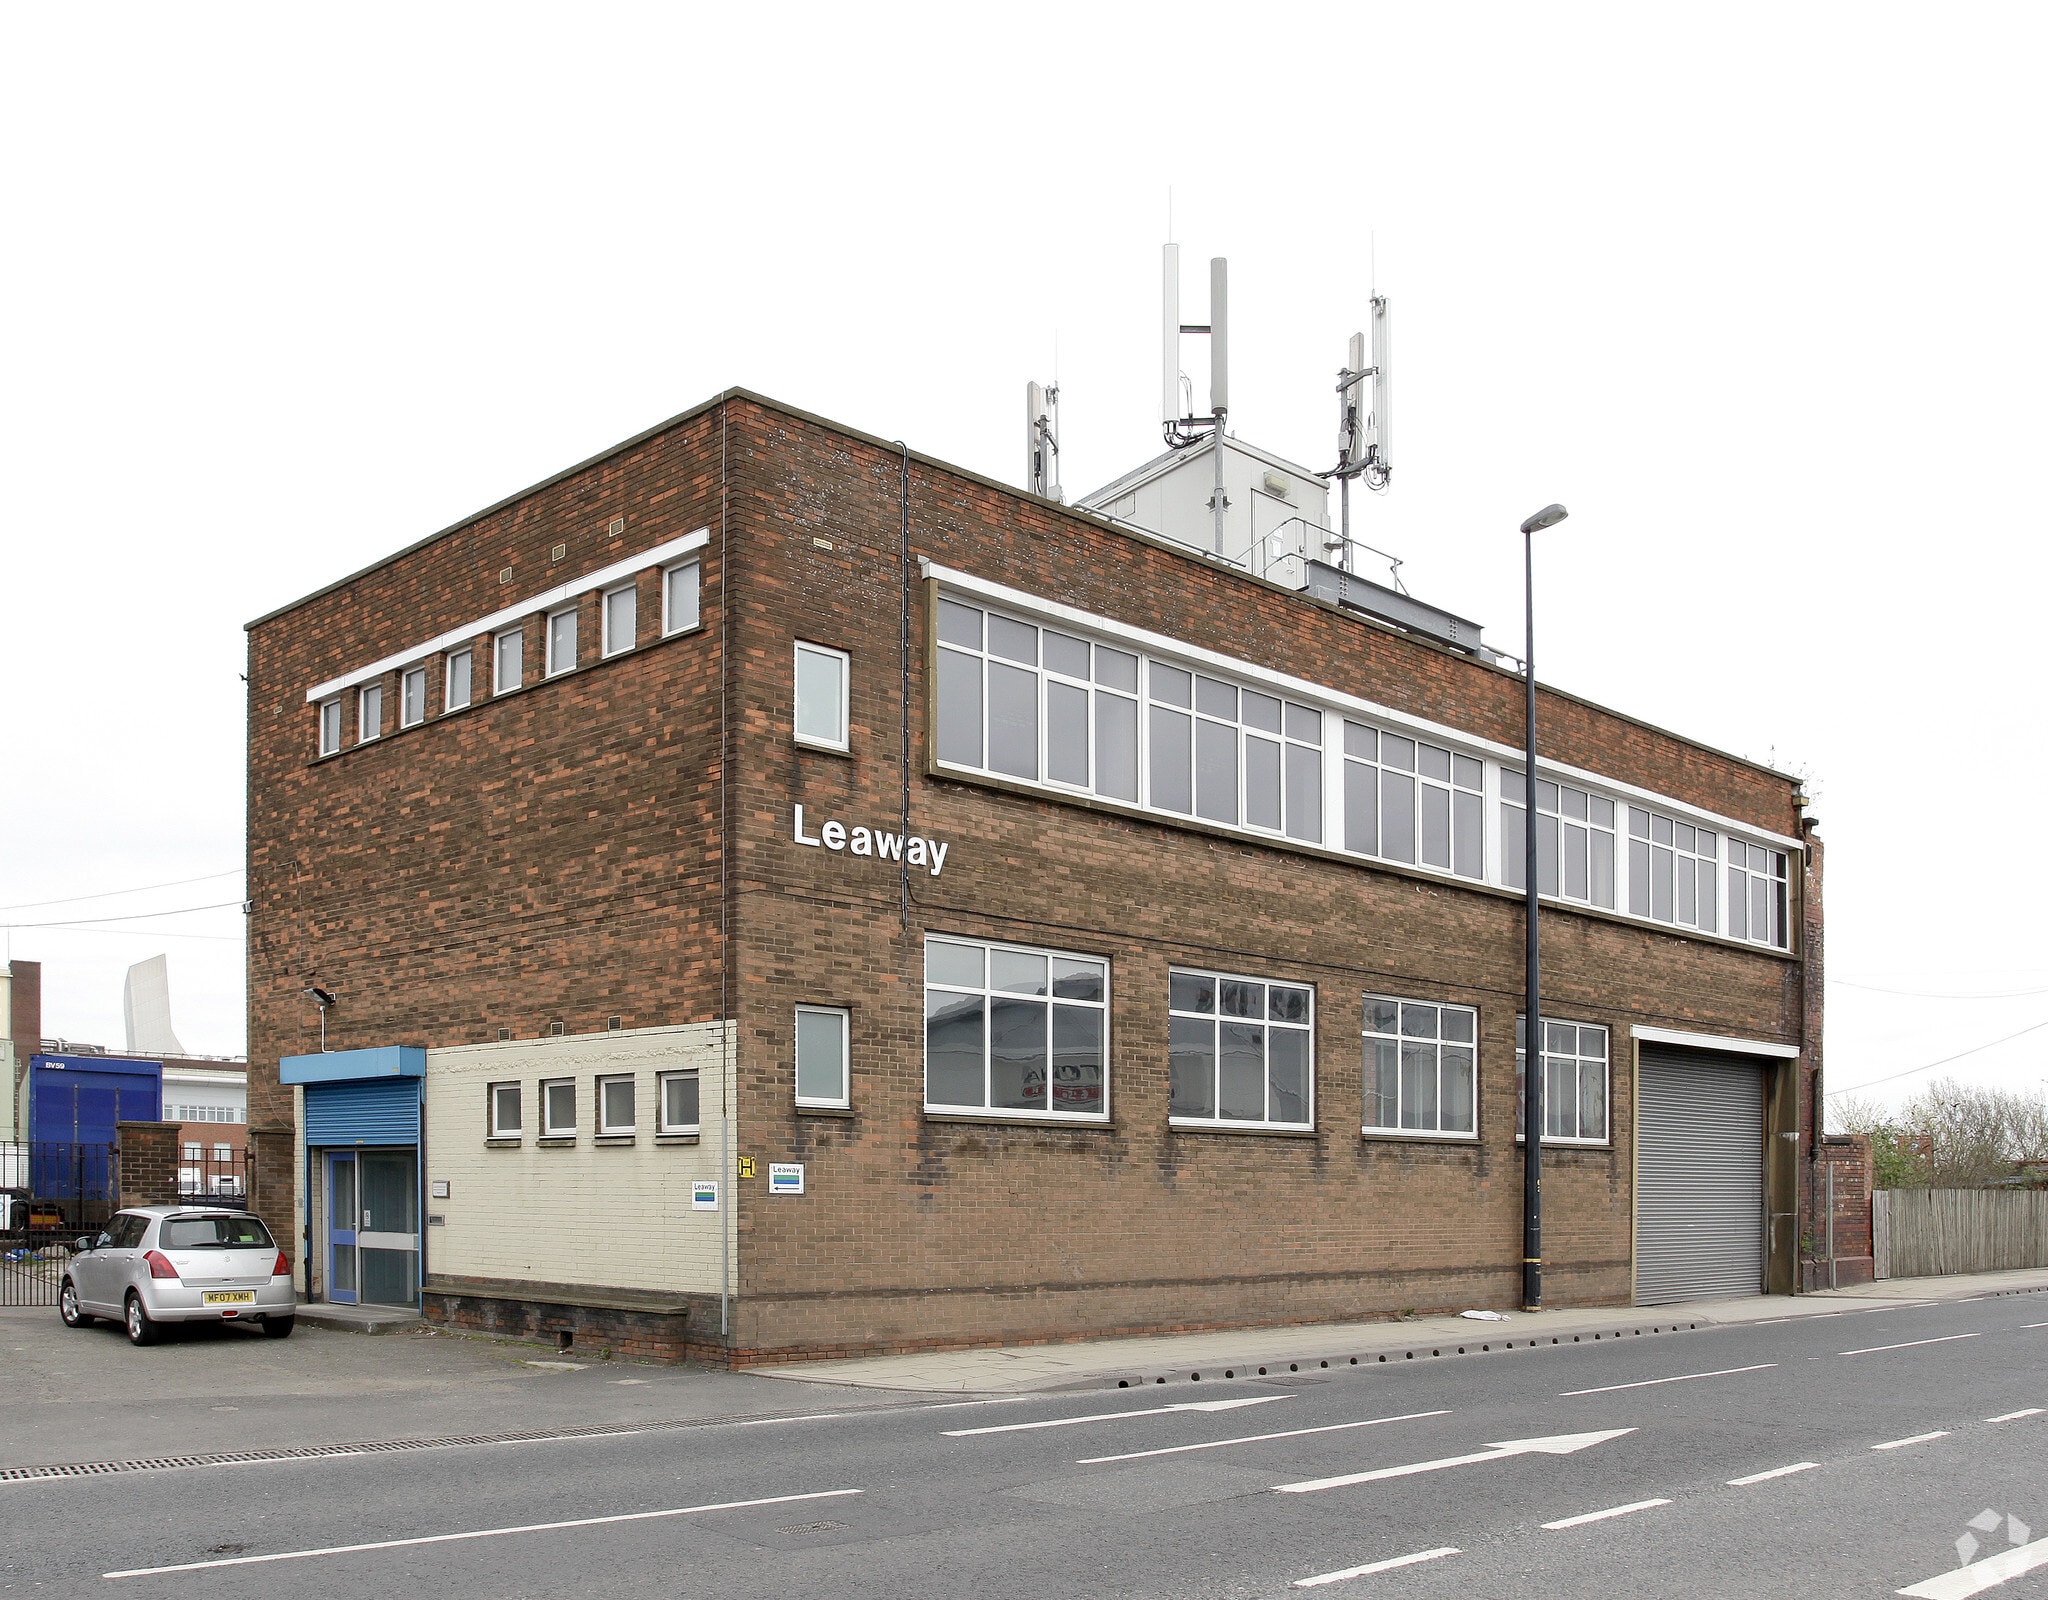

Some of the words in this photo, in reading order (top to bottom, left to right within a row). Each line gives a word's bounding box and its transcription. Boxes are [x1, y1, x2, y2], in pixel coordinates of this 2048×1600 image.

[794, 803, 949, 876] Leaway
[741, 1158, 752, 1176] H
[773, 1165, 800, 1174] Leaway
[694, 1183, 715, 1191] Leaway
[208, 1293, 231, 1302] MF07
[232, 1292, 250, 1301] XMH
